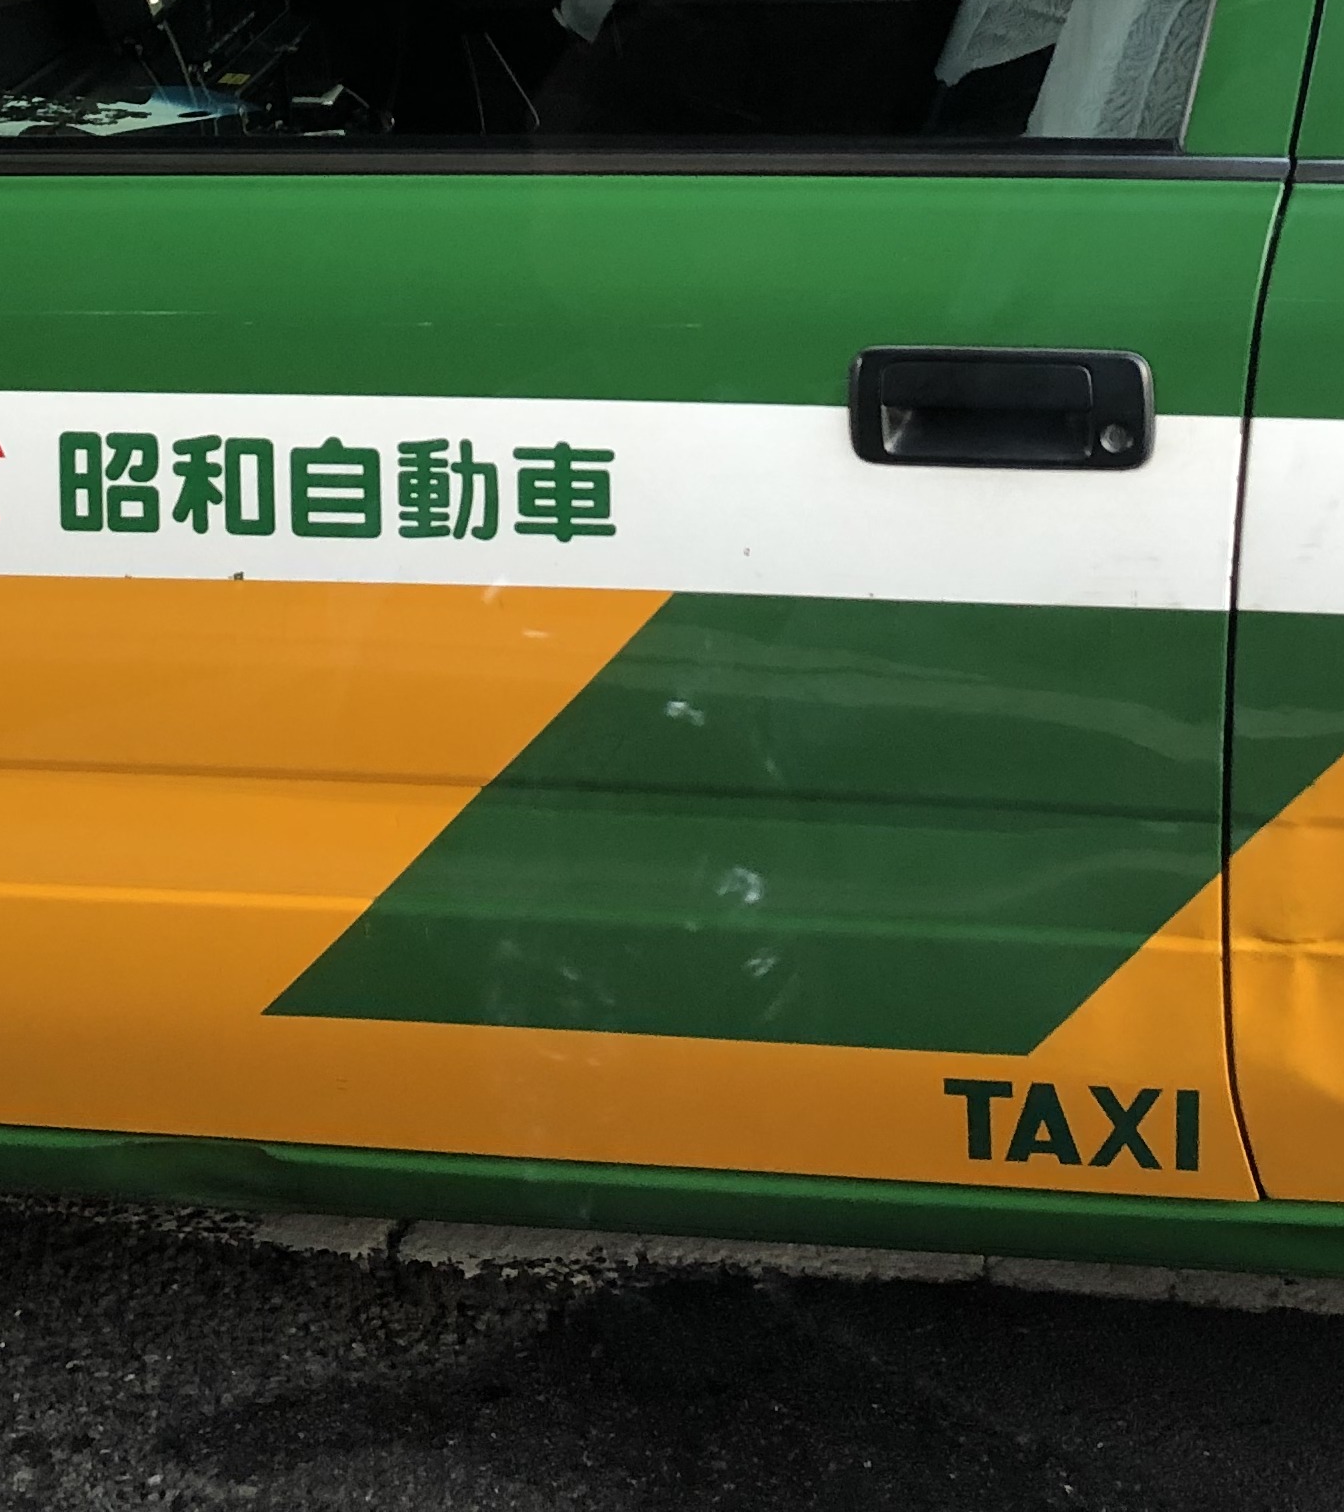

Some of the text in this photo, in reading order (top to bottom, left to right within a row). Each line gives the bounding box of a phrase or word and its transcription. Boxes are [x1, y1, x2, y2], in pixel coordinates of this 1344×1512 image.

[58, 429, 618, 543] 昭和自動車
[943, 1077, 1200, 1172] TAXI
